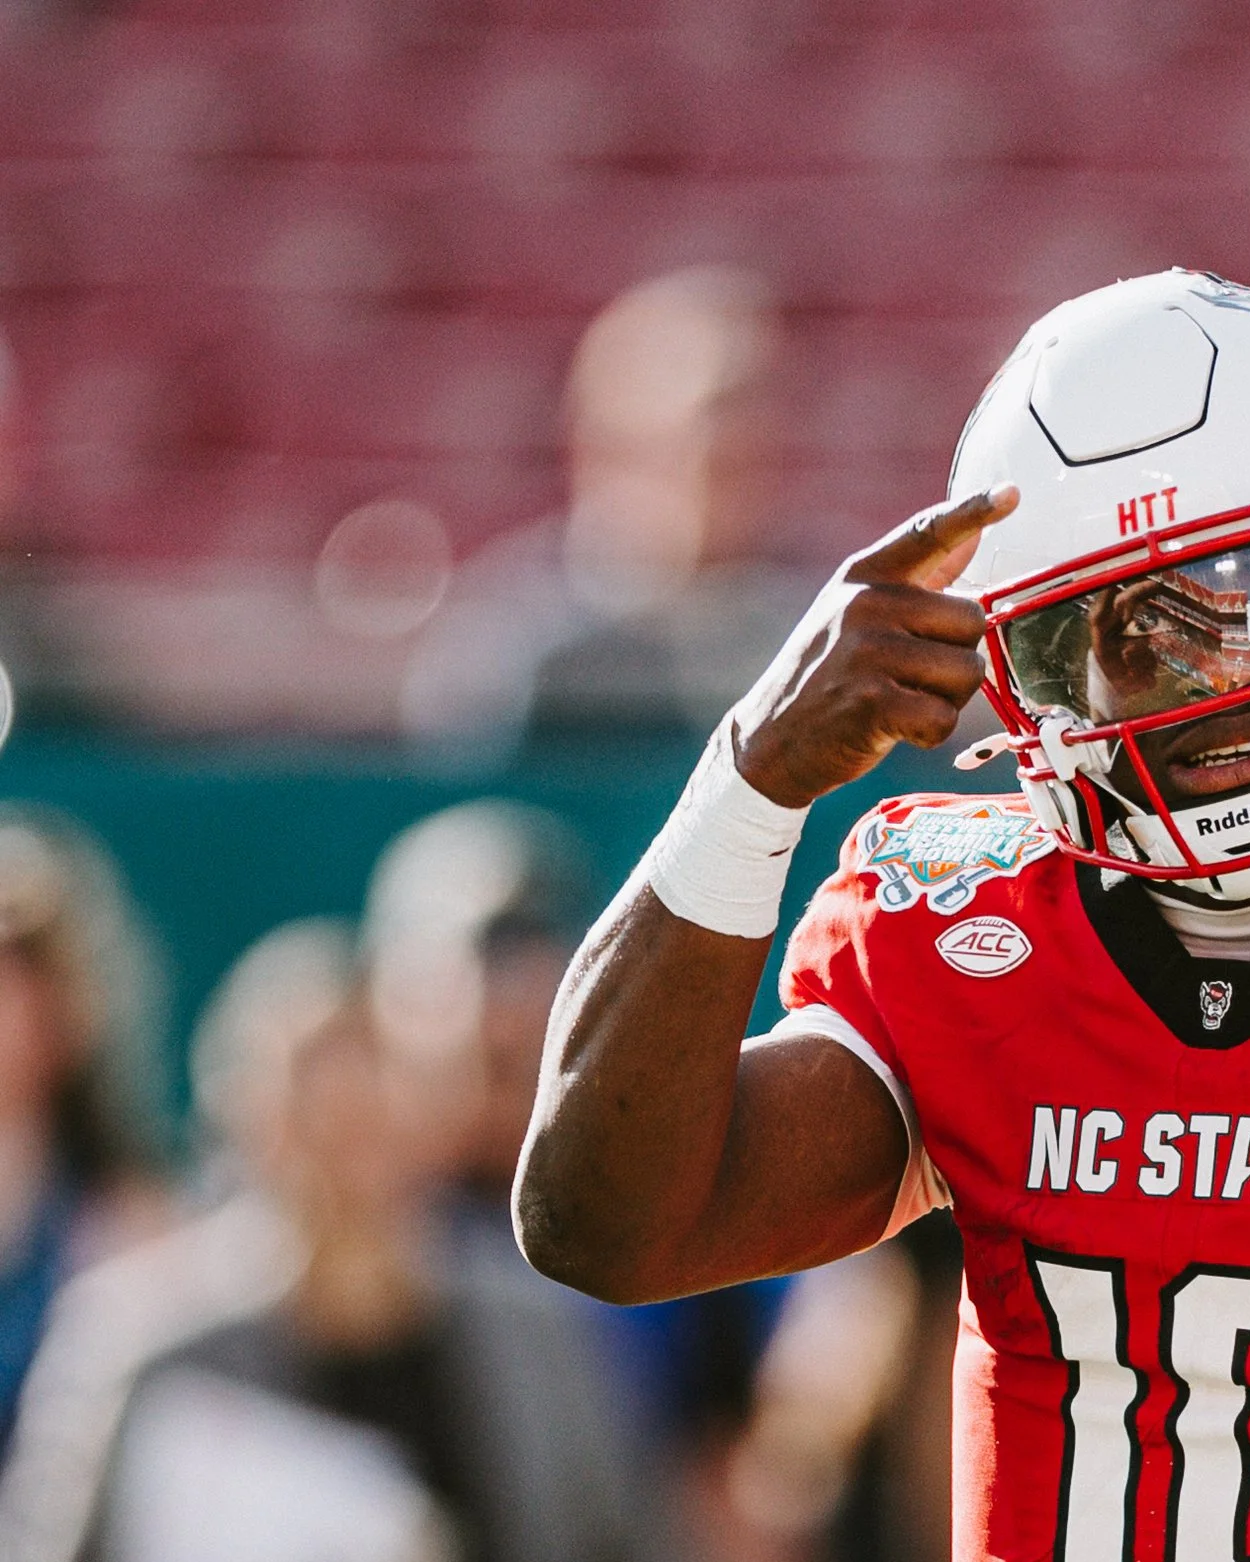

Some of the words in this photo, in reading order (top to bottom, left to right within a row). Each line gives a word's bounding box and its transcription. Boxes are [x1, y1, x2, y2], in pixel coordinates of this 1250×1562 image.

[1117, 486, 1178, 536] HTT
[906, 847, 982, 866] BOWL
[951, 932, 1017, 953] ACC
[1025, 1104, 1125, 1194] NC
